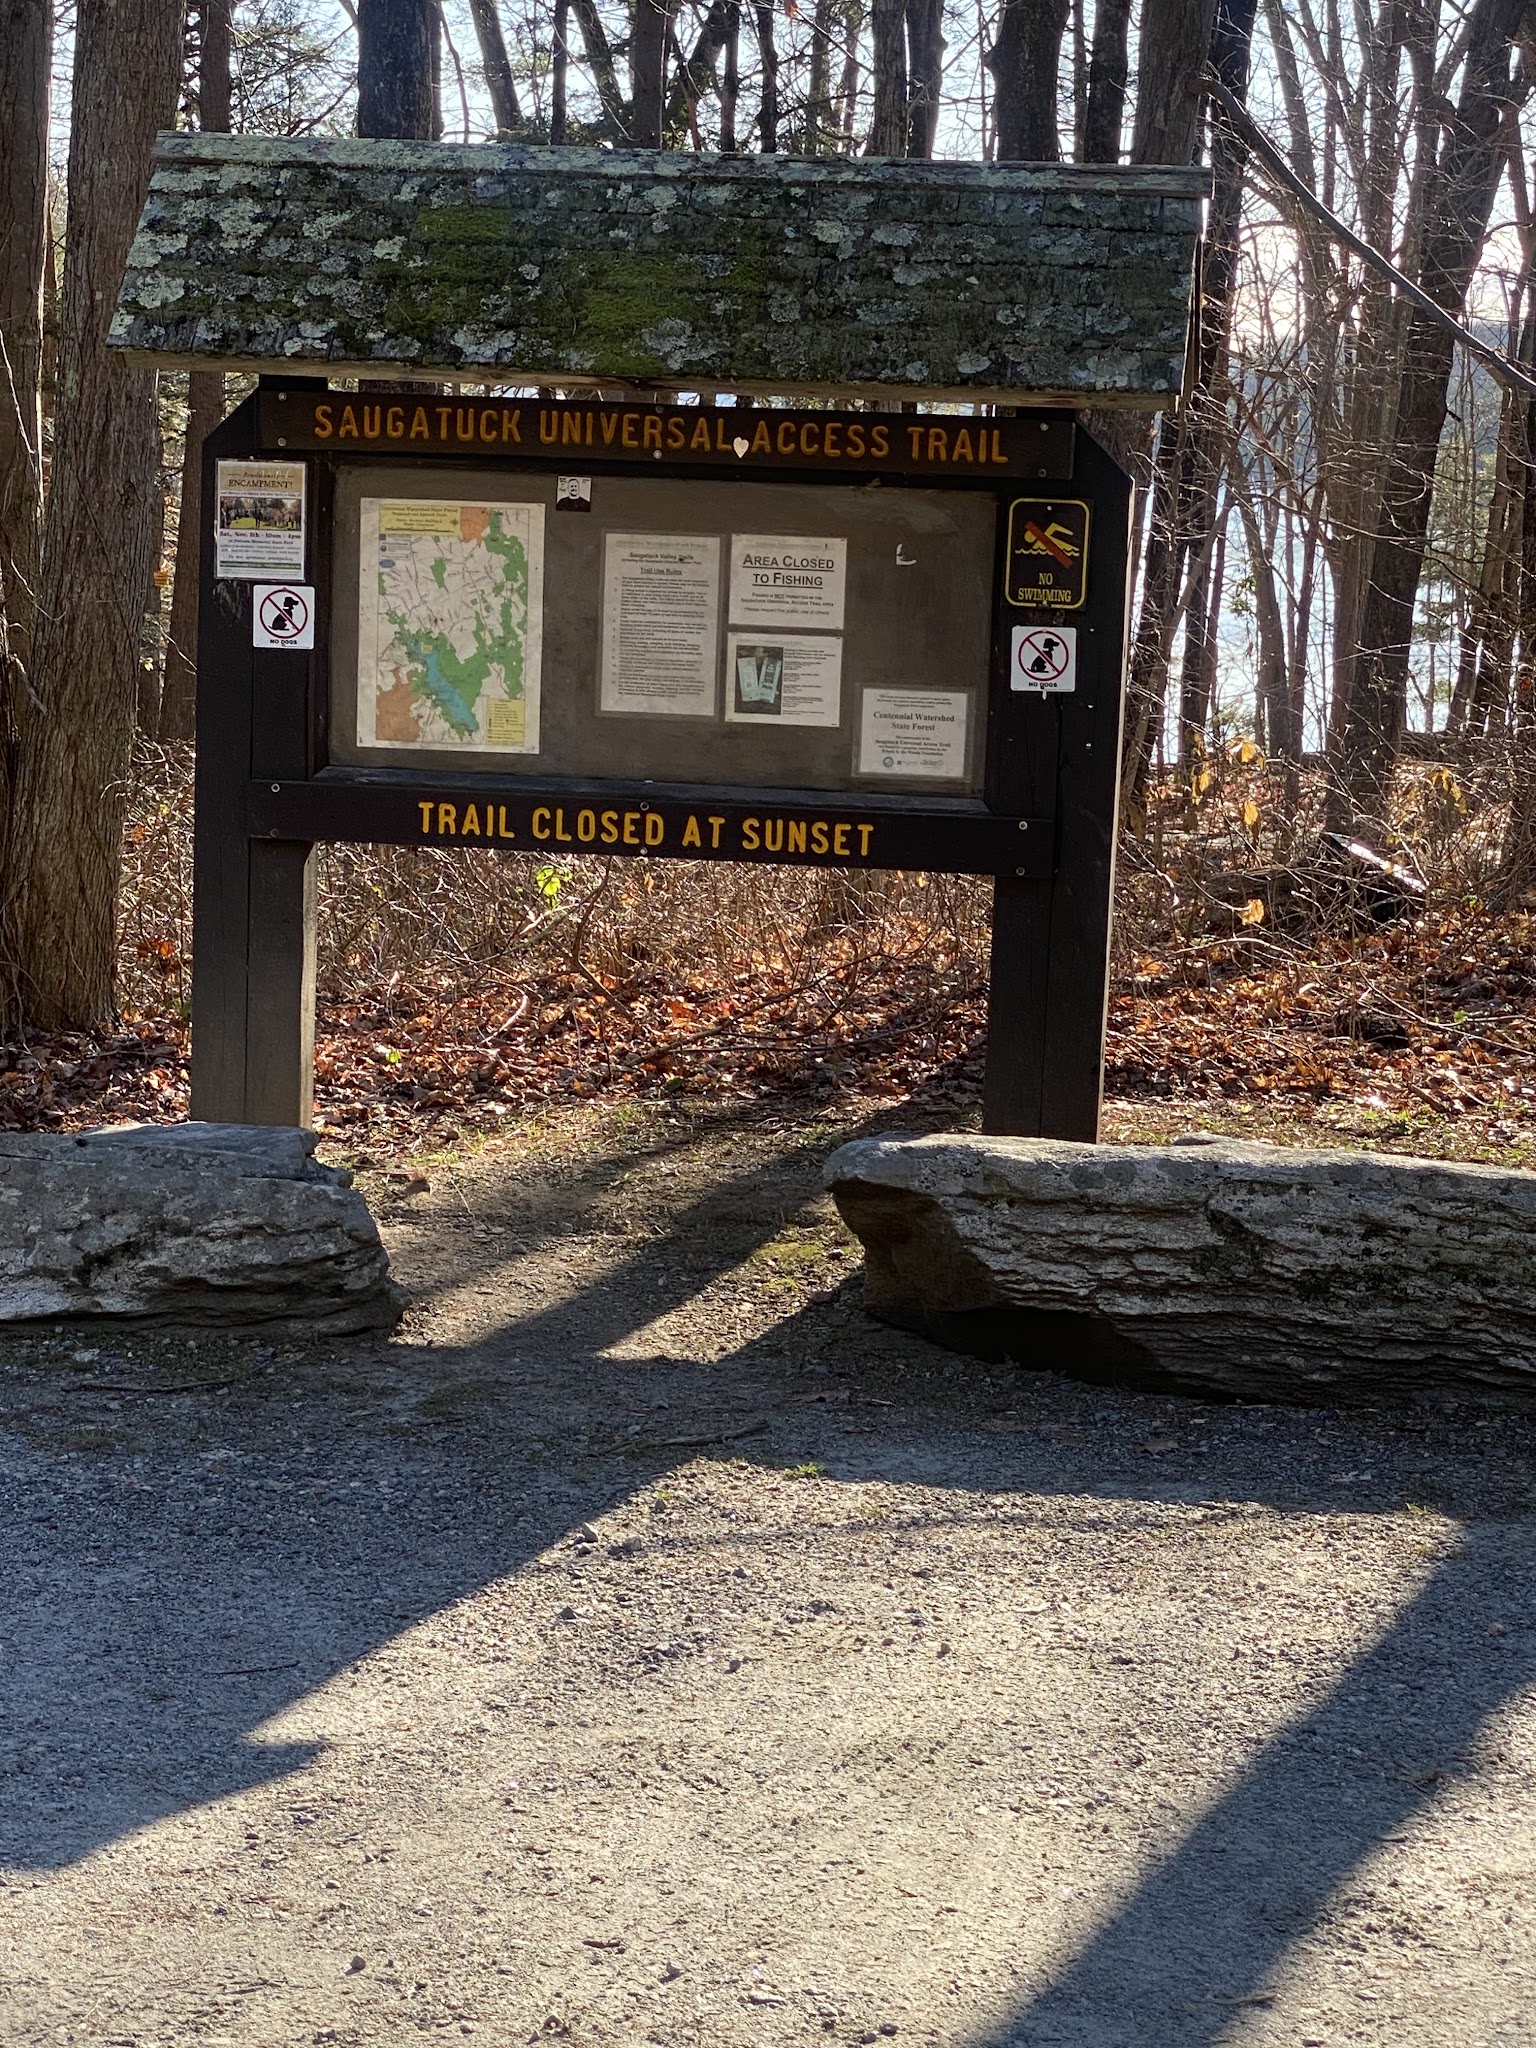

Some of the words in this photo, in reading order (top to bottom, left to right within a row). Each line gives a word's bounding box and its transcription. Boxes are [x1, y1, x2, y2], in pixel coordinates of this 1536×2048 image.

[315, 405, 521, 443] SAUGATUCK
[540, 410, 732, 451] UNIVERSAL
[751, 421, 889, 458] ACCESS
[907, 427, 1008, 463] TRAIL
[742, 554, 779, 566] AREA
[782, 555, 834, 569] CLOSED
[773, 572, 823, 586] FISHING
[1038, 572, 1053, 585] NO
[1018, 588, 1072, 602] SWIMMING
[874, 712, 913, 720] Centennial
[915, 713, 954, 722] Watershed
[418, 801, 514, 839] TRAIL
[532, 807, 664, 845] CLOSED
[682, 815, 726, 848] AT
[742, 818, 874, 856] SUNSET
